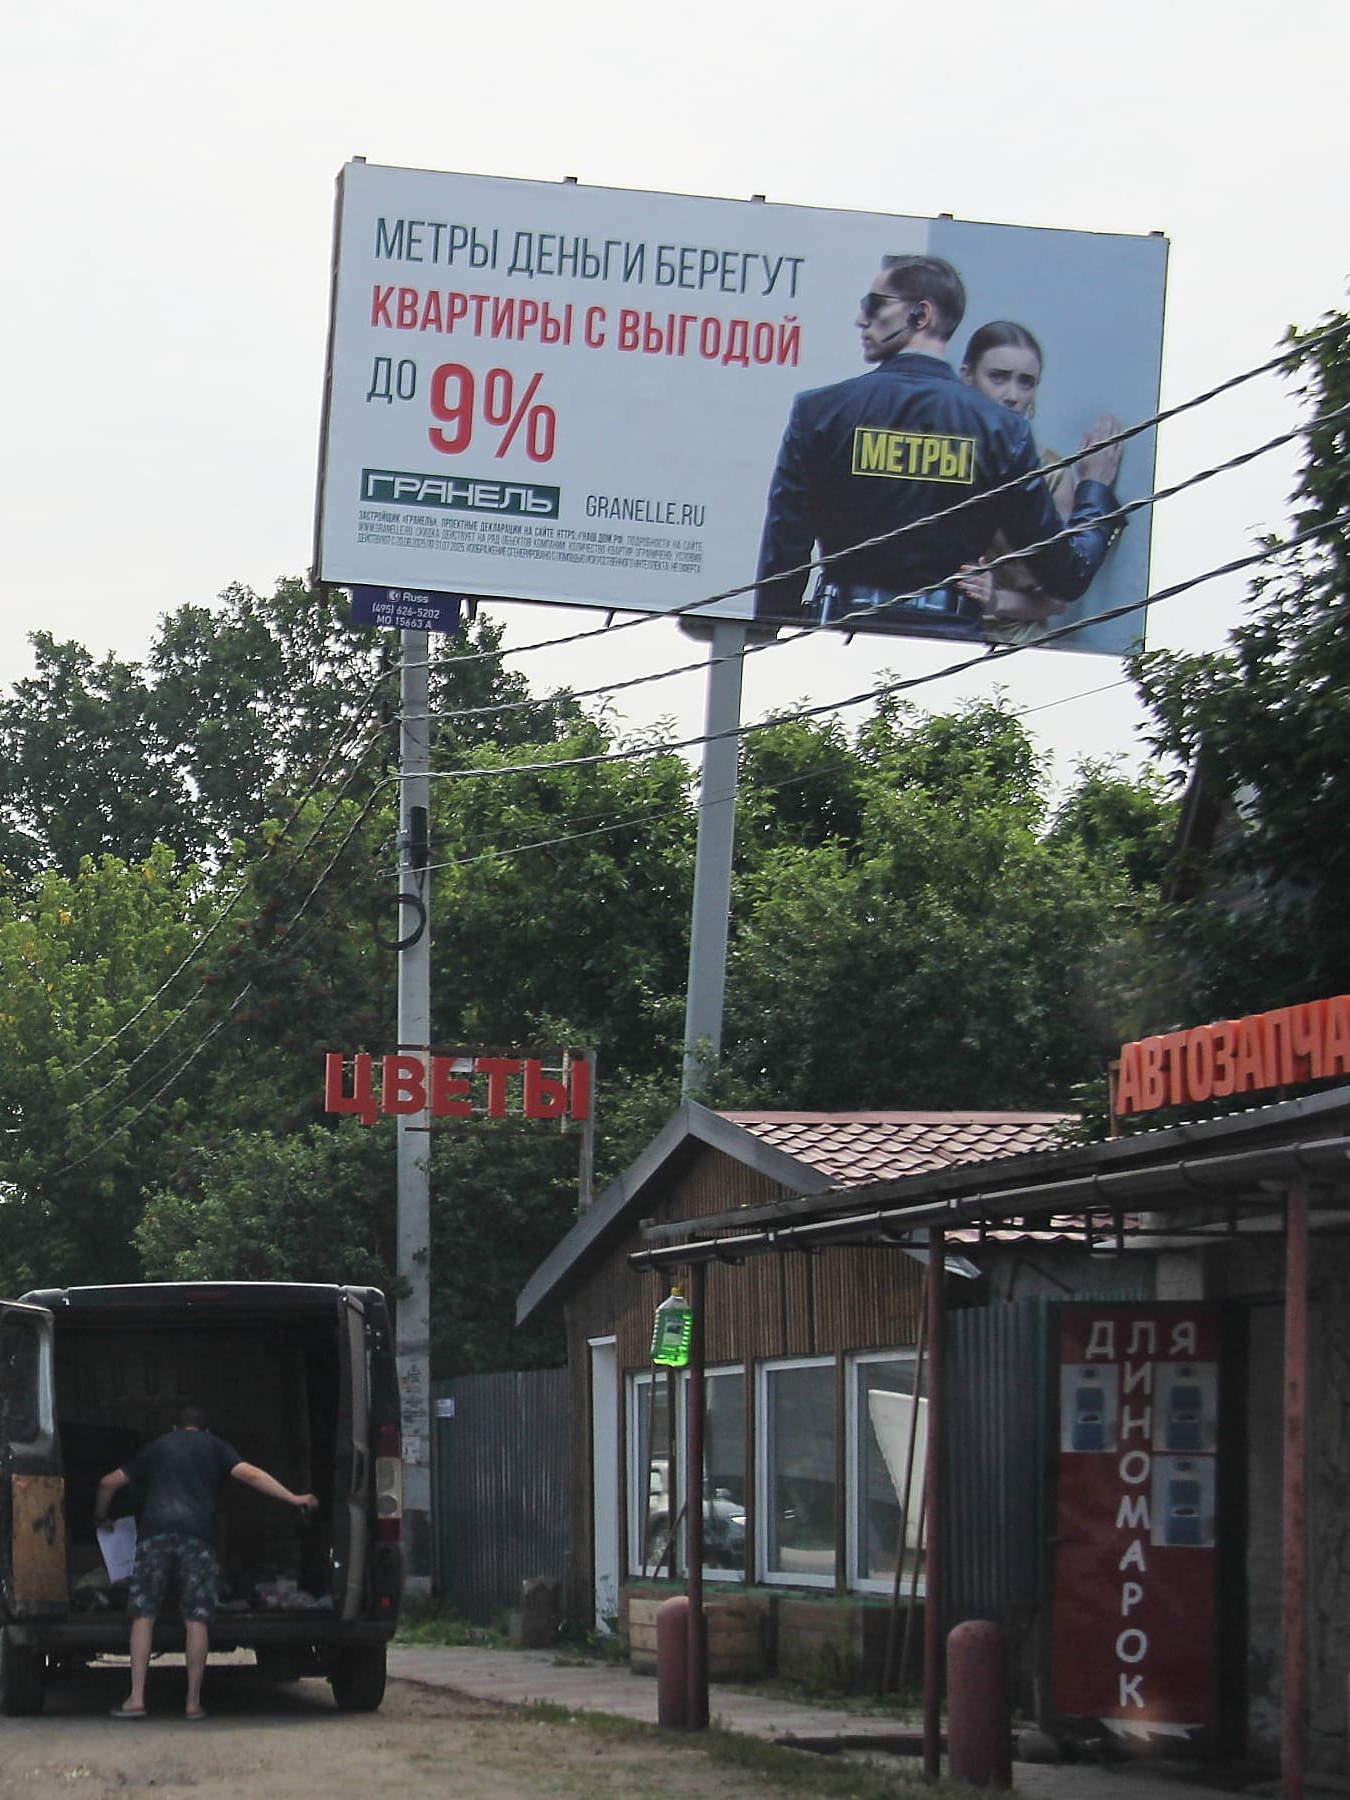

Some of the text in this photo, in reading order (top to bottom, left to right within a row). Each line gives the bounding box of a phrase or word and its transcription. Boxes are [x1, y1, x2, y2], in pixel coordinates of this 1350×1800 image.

[374, 217, 805, 298] МЕТРЫ ДЕНЬГИ БЕРЕГУТ
[370, 284, 803, 367] КВАРТИРЫ С ВЫГОДОЙ
[366, 356, 557, 464] ДО 9%
[860, 431, 970, 480] МЕТРЫ
[366, 474, 554, 514] ГРАНЕЛЬ
[586, 495, 706, 528] GRANELLE.RU
[442, 518, 478, 530] ПРОЕКТНЫЕ
[535, 526, 554, 537] САЙТЕ
[371, 602, 440, 619] (495) 626-5202
[402, 592, 429, 604] Russ
[395, 617, 422, 629] 15663
[325, 1053, 590, 1125] ЦВЕТЫ
[1085, 1320, 1197, 1360] ДЛЯ
[1114, 1361, 1151, 1709] ИНОМАРОК
